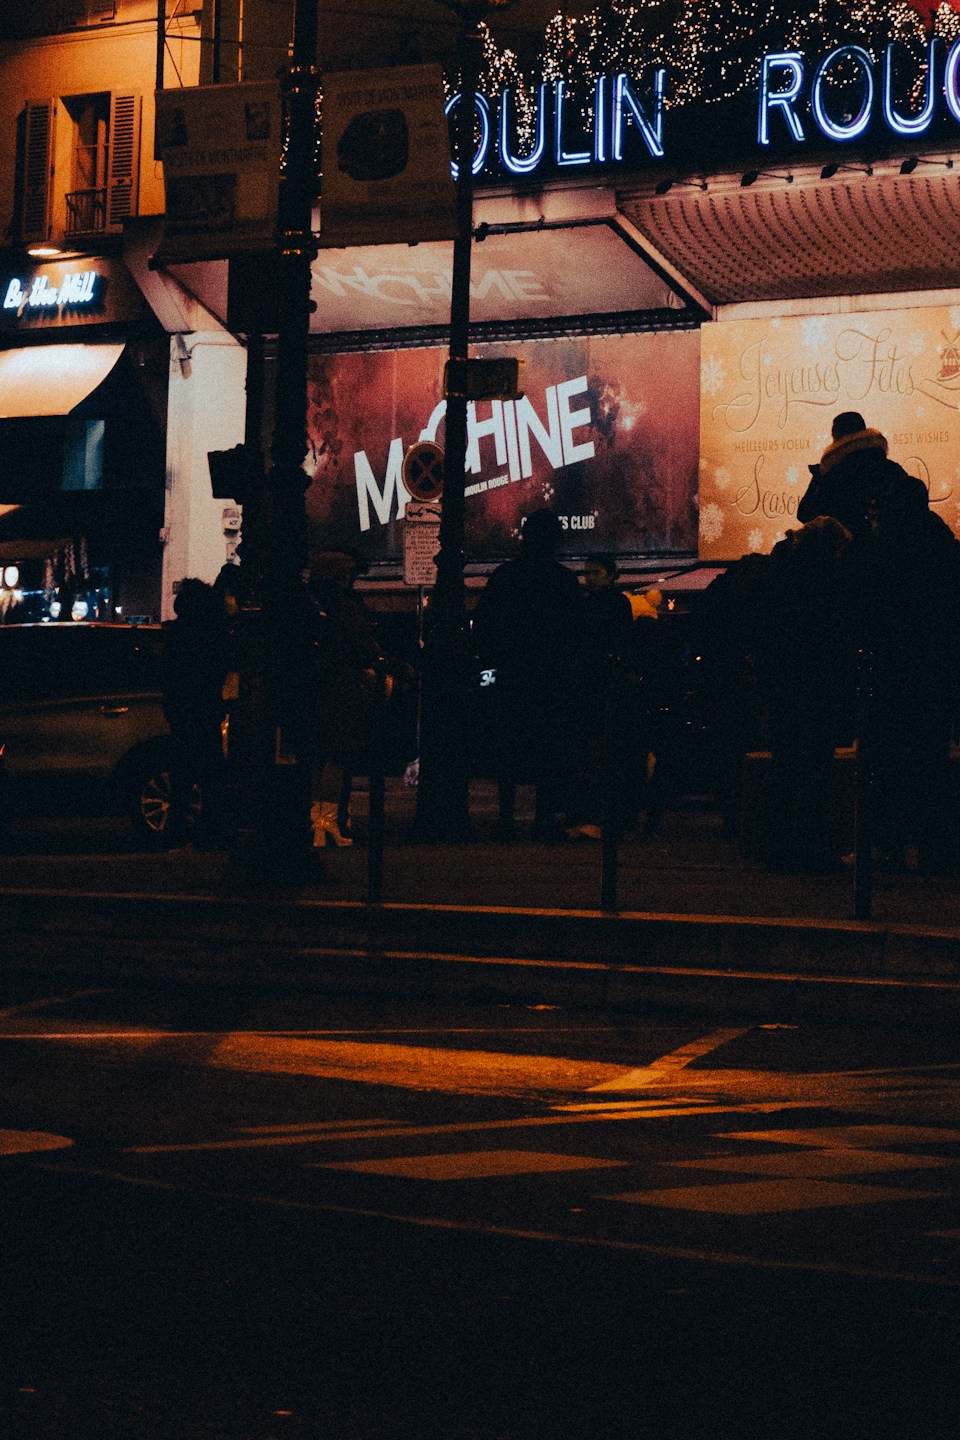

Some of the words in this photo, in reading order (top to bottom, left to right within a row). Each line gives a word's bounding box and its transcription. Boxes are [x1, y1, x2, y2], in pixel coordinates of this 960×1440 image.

[444, 68, 664, 180] OULIN
[56, 270, 97, 305] Mill
[712, 334, 841, 434] Joyeuses
[354, 375, 596, 533] MHINE
[893, 432, 913, 445] BEST
[915, 430, 950, 444] WISHES
[729, 454, 799, 520] Seaso
[570, 515, 596, 531] CLUB
